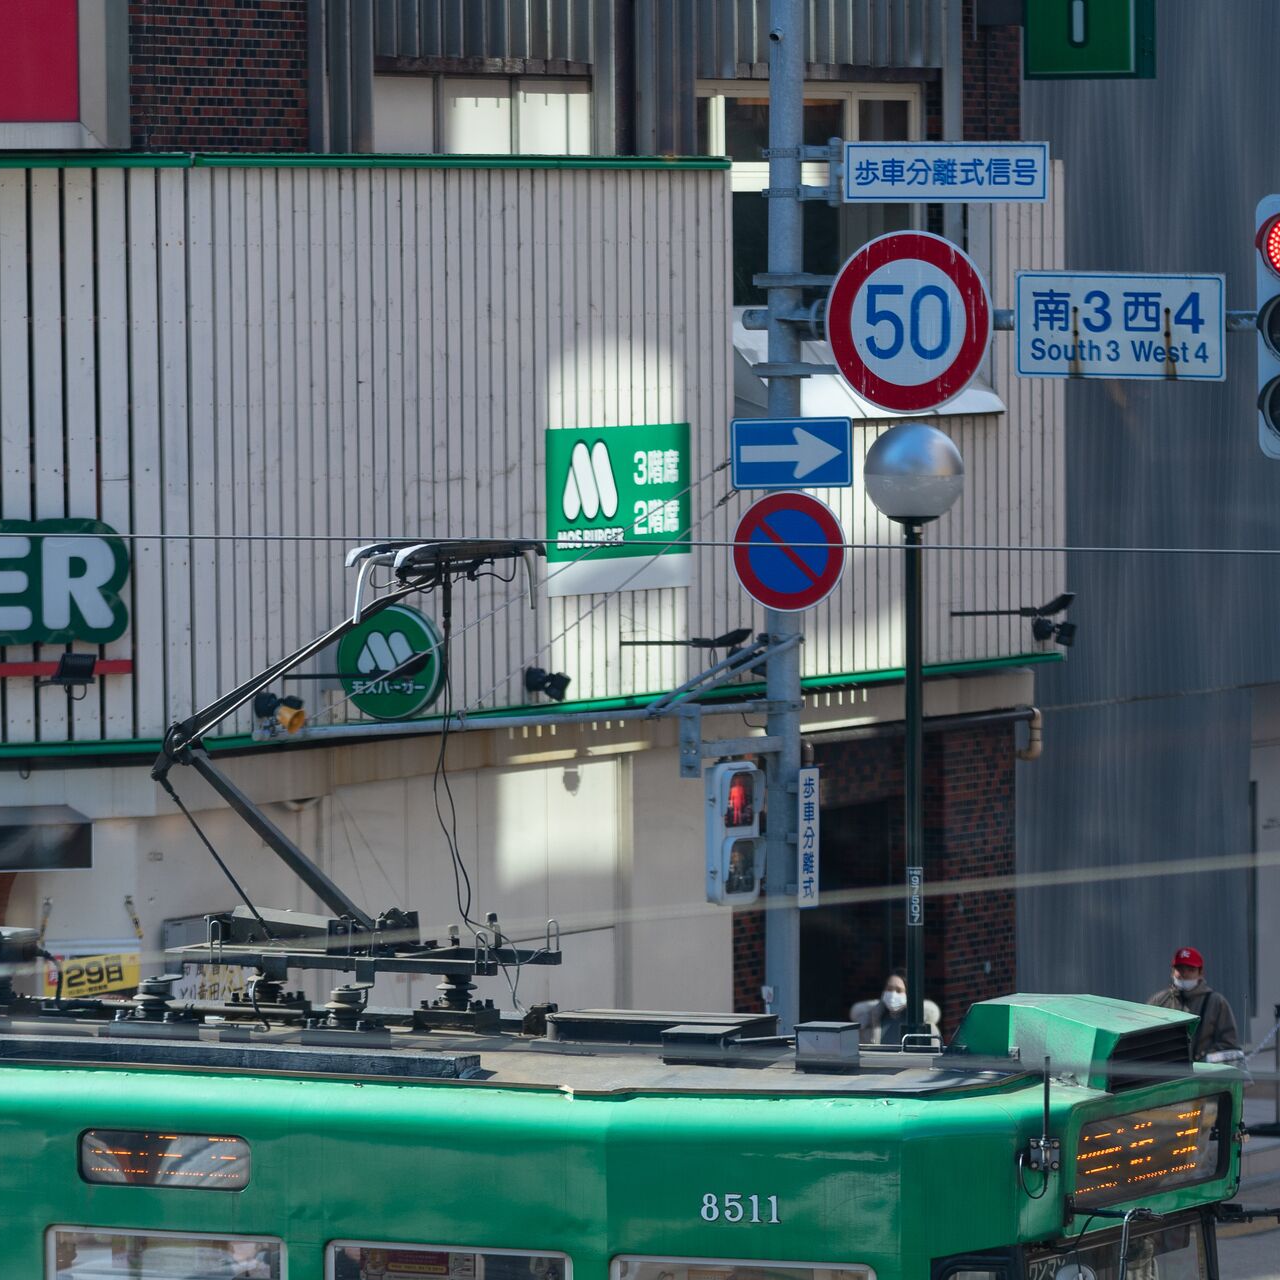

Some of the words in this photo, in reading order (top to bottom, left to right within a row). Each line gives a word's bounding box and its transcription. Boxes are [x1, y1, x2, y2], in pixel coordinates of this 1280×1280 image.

[855, 157, 1038, 187] 歩車分離式信号
[866, 284, 951, 360] 50
[1032, 289, 1205, 334] 南3西4
[633, 449, 680, 486] 3階席
[633, 499, 680, 535] 2階席
[557, 529, 582, 549] MOS
[583, 527, 624, 548] BURGER
[352, 680, 426, 695] モスバーガー
[803, 776, 815, 899] 歩車分離式
[65, 956, 124, 988] 29日
[700, 1193, 781, 1224] 8511
